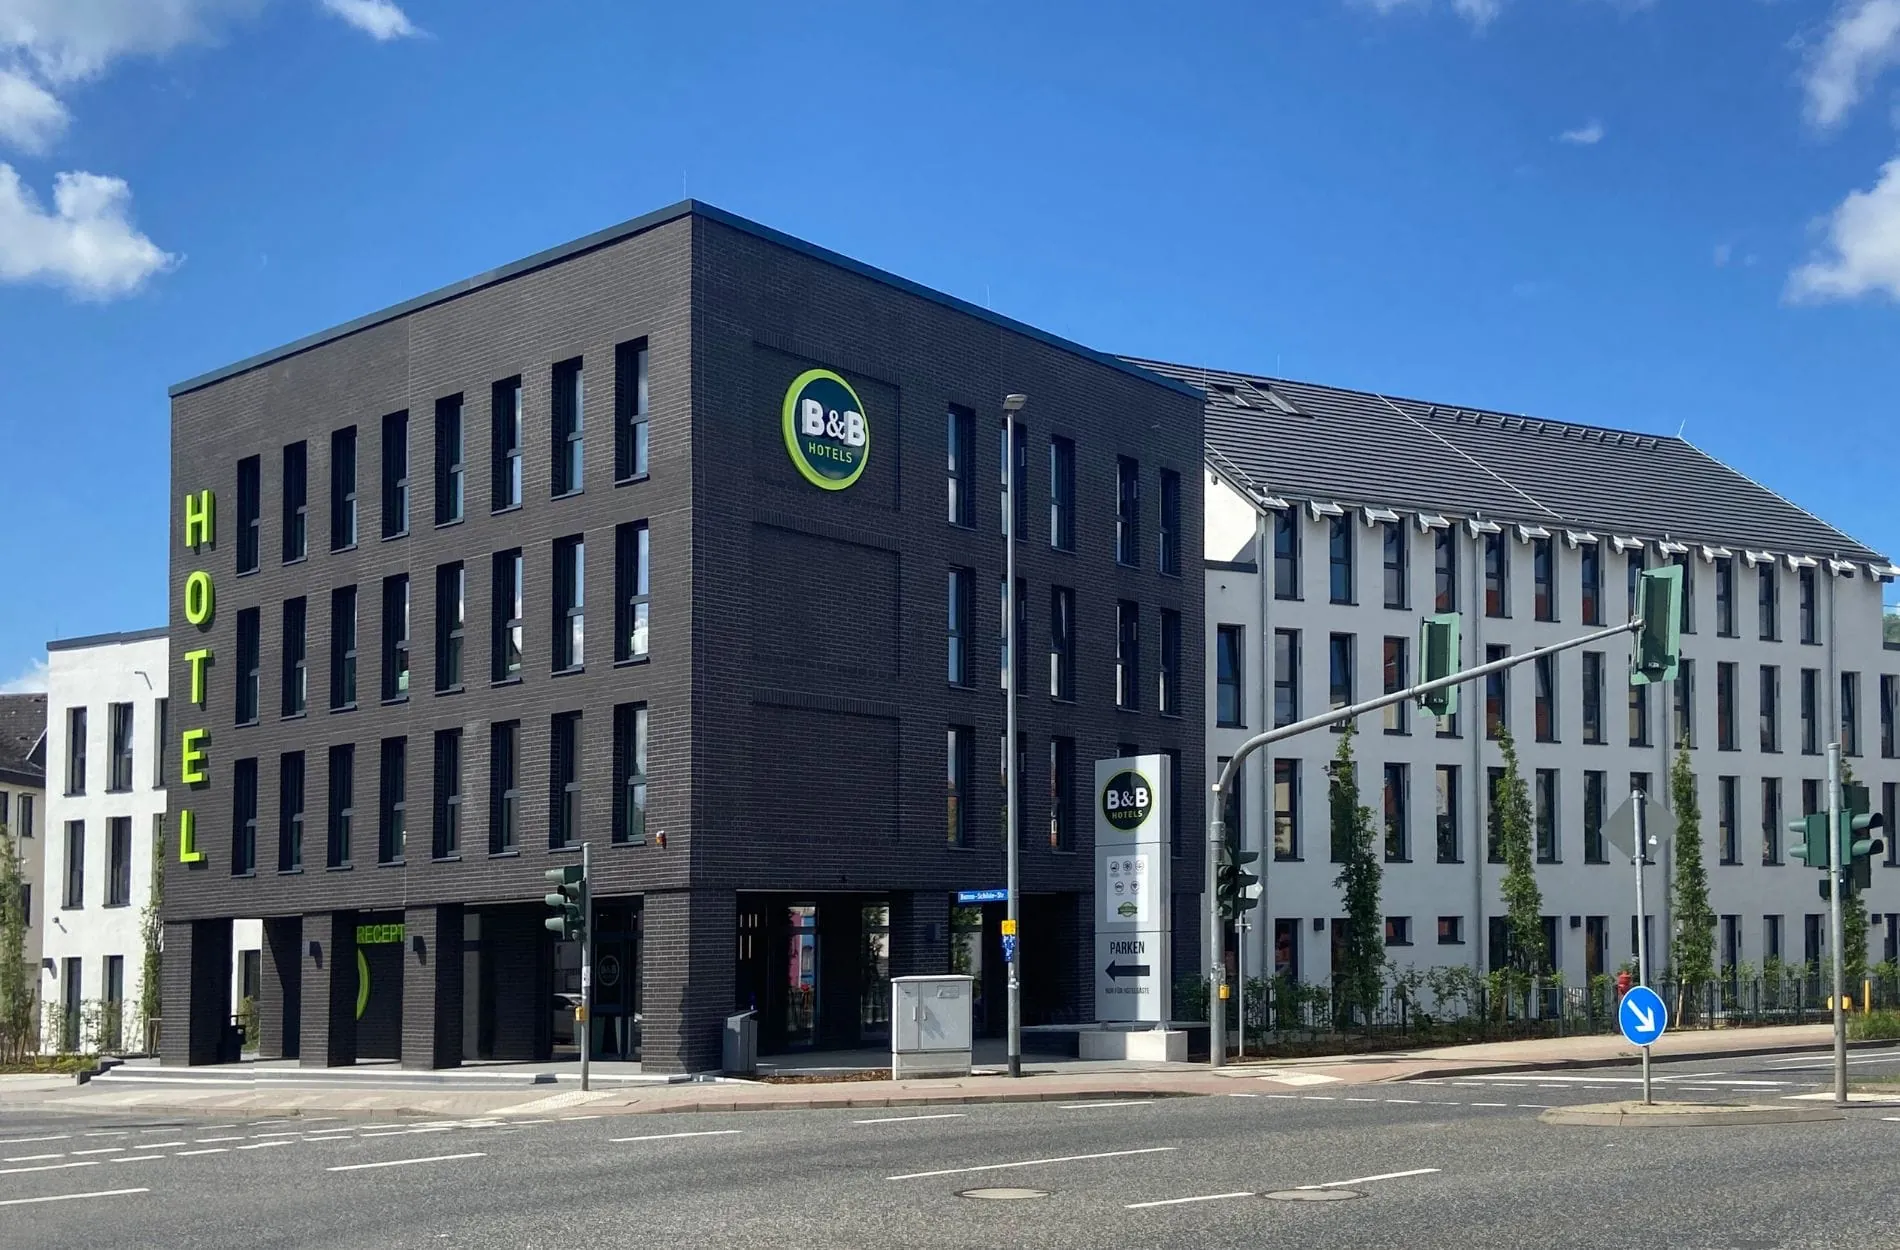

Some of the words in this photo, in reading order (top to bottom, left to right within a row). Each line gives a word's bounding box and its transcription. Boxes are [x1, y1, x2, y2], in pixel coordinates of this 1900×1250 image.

[802, 398, 866, 447] B&B
[808, 441, 853, 464] HOTELS
[179, 489, 214, 863] HOTEL
[1107, 787, 1149, 810] B&B
[1111, 809, 1143, 820] HOTELS
[1110, 941, 1145, 955] PARKEN
